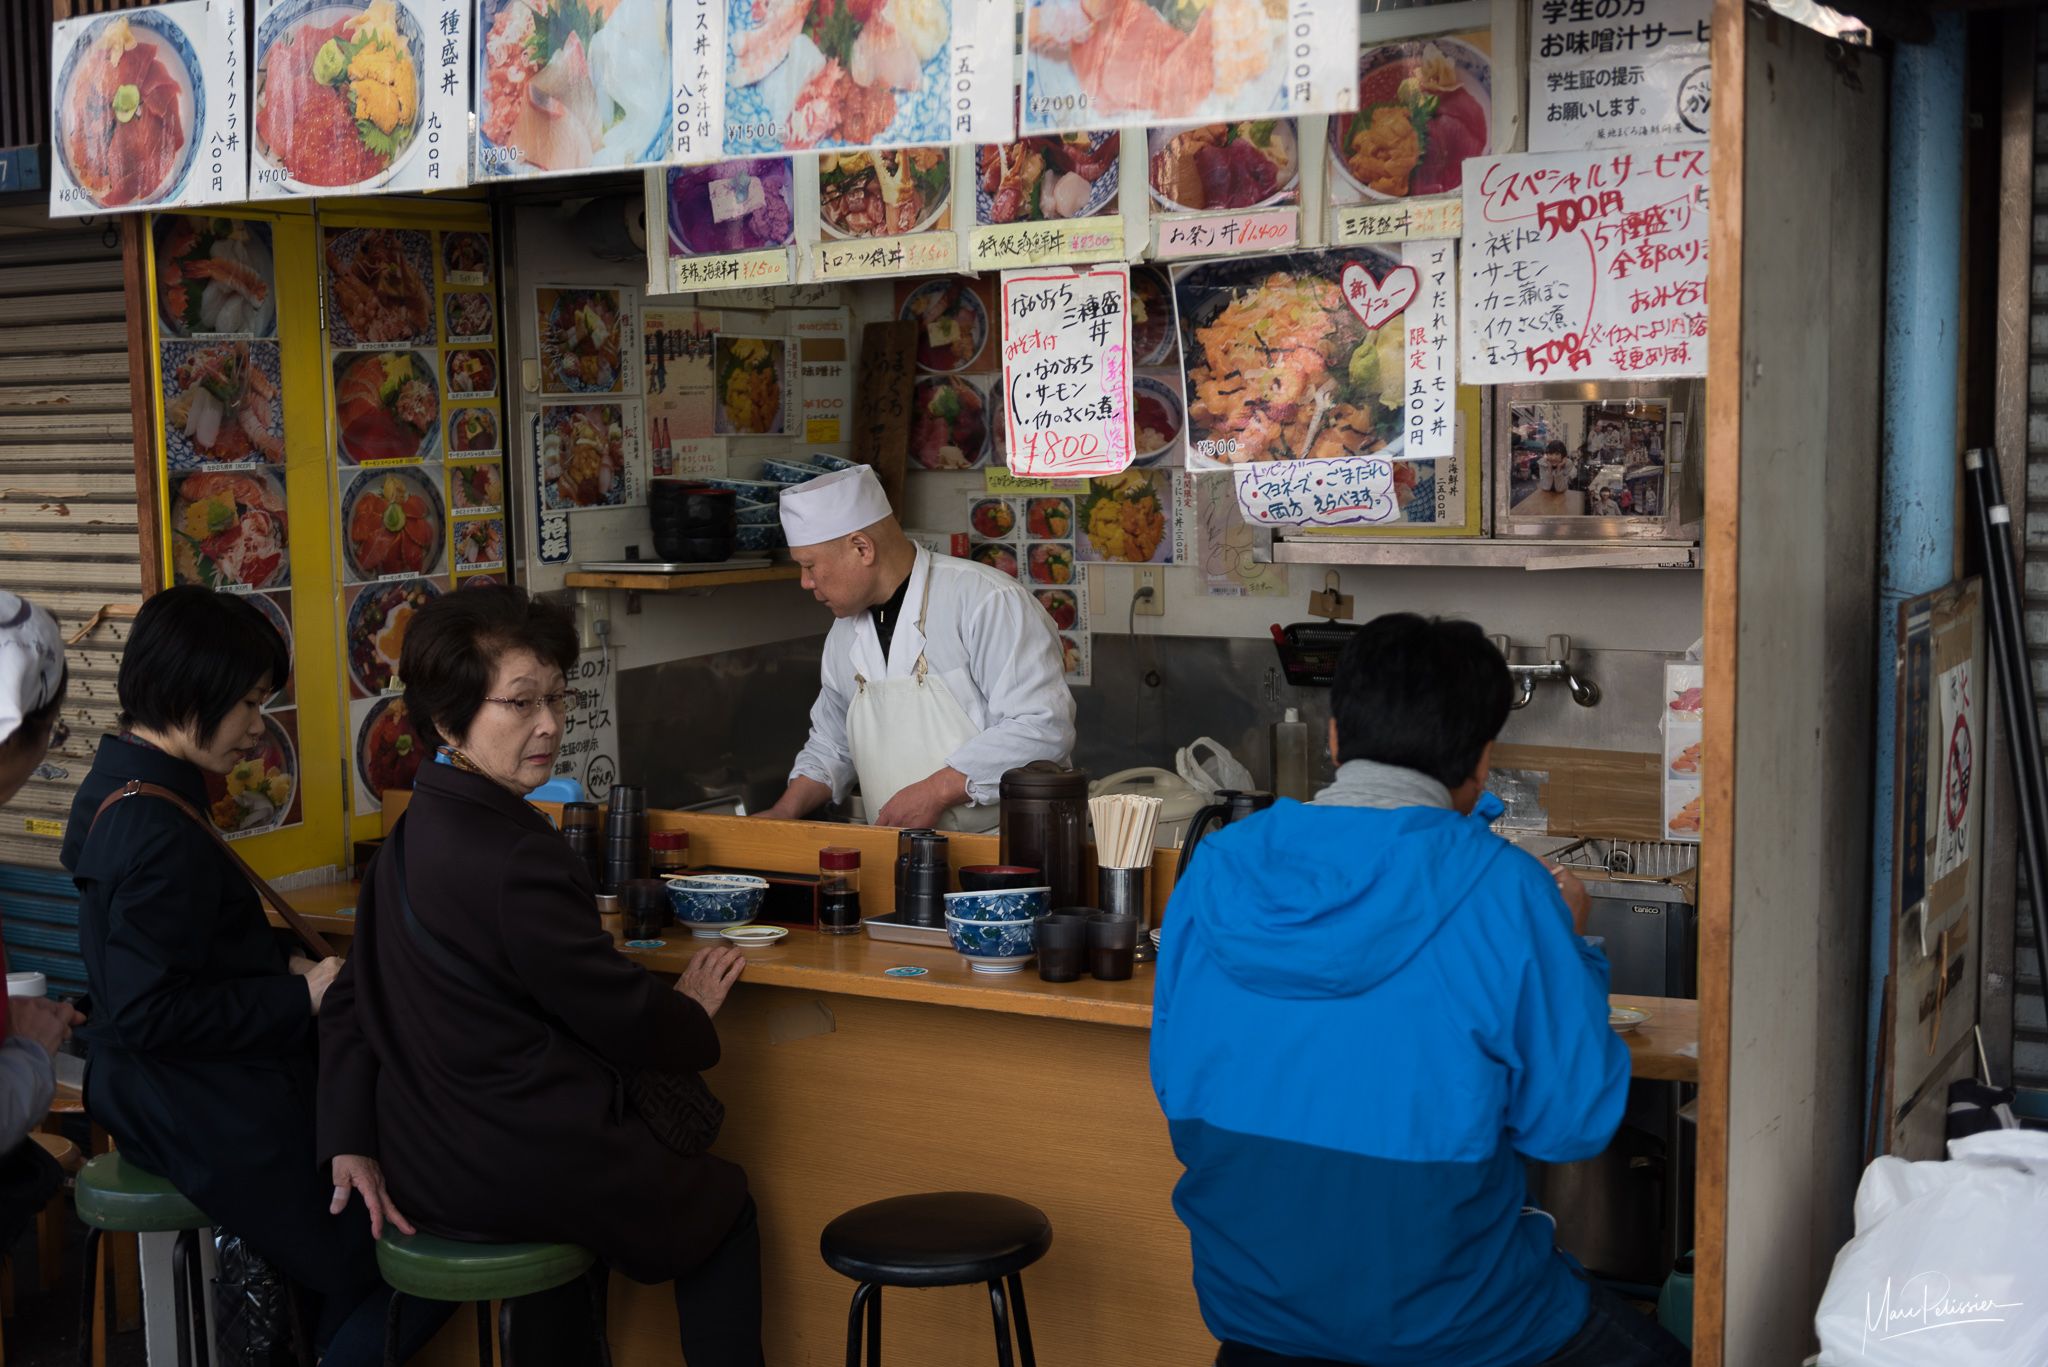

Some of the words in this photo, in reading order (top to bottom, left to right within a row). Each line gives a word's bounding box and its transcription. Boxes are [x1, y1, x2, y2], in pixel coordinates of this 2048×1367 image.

[1542, 0, 1646, 24] 学生の方
[440, 0, 460, 96] 種盛丼
[226, 7, 240, 152] まぐろイクラ丼
[1547, 66, 1645, 92] 学生証の提示
[1547, 96, 1647, 122] お願いします。
[1537, 190, 1625, 242] 500円
[1169, 219, 1240, 247] お祭り丼
[1482, 260, 1550, 287] サーモン
[1350, 279, 1368, 300] 新
[1409, 328, 1428, 370] 限定
[1430, 248, 1448, 437] ゴマだれサーモン丼
[1035, 383, 1088, 406] サーモン
[1258, 471, 1312, 500] マヨネーズ
[1326, 462, 1389, 486] ごまだれ
[566, 710, 611, 734] サービス
[558, 738, 599, 758] 生証の提示
[1633, 905, 1660, 914] tanico
